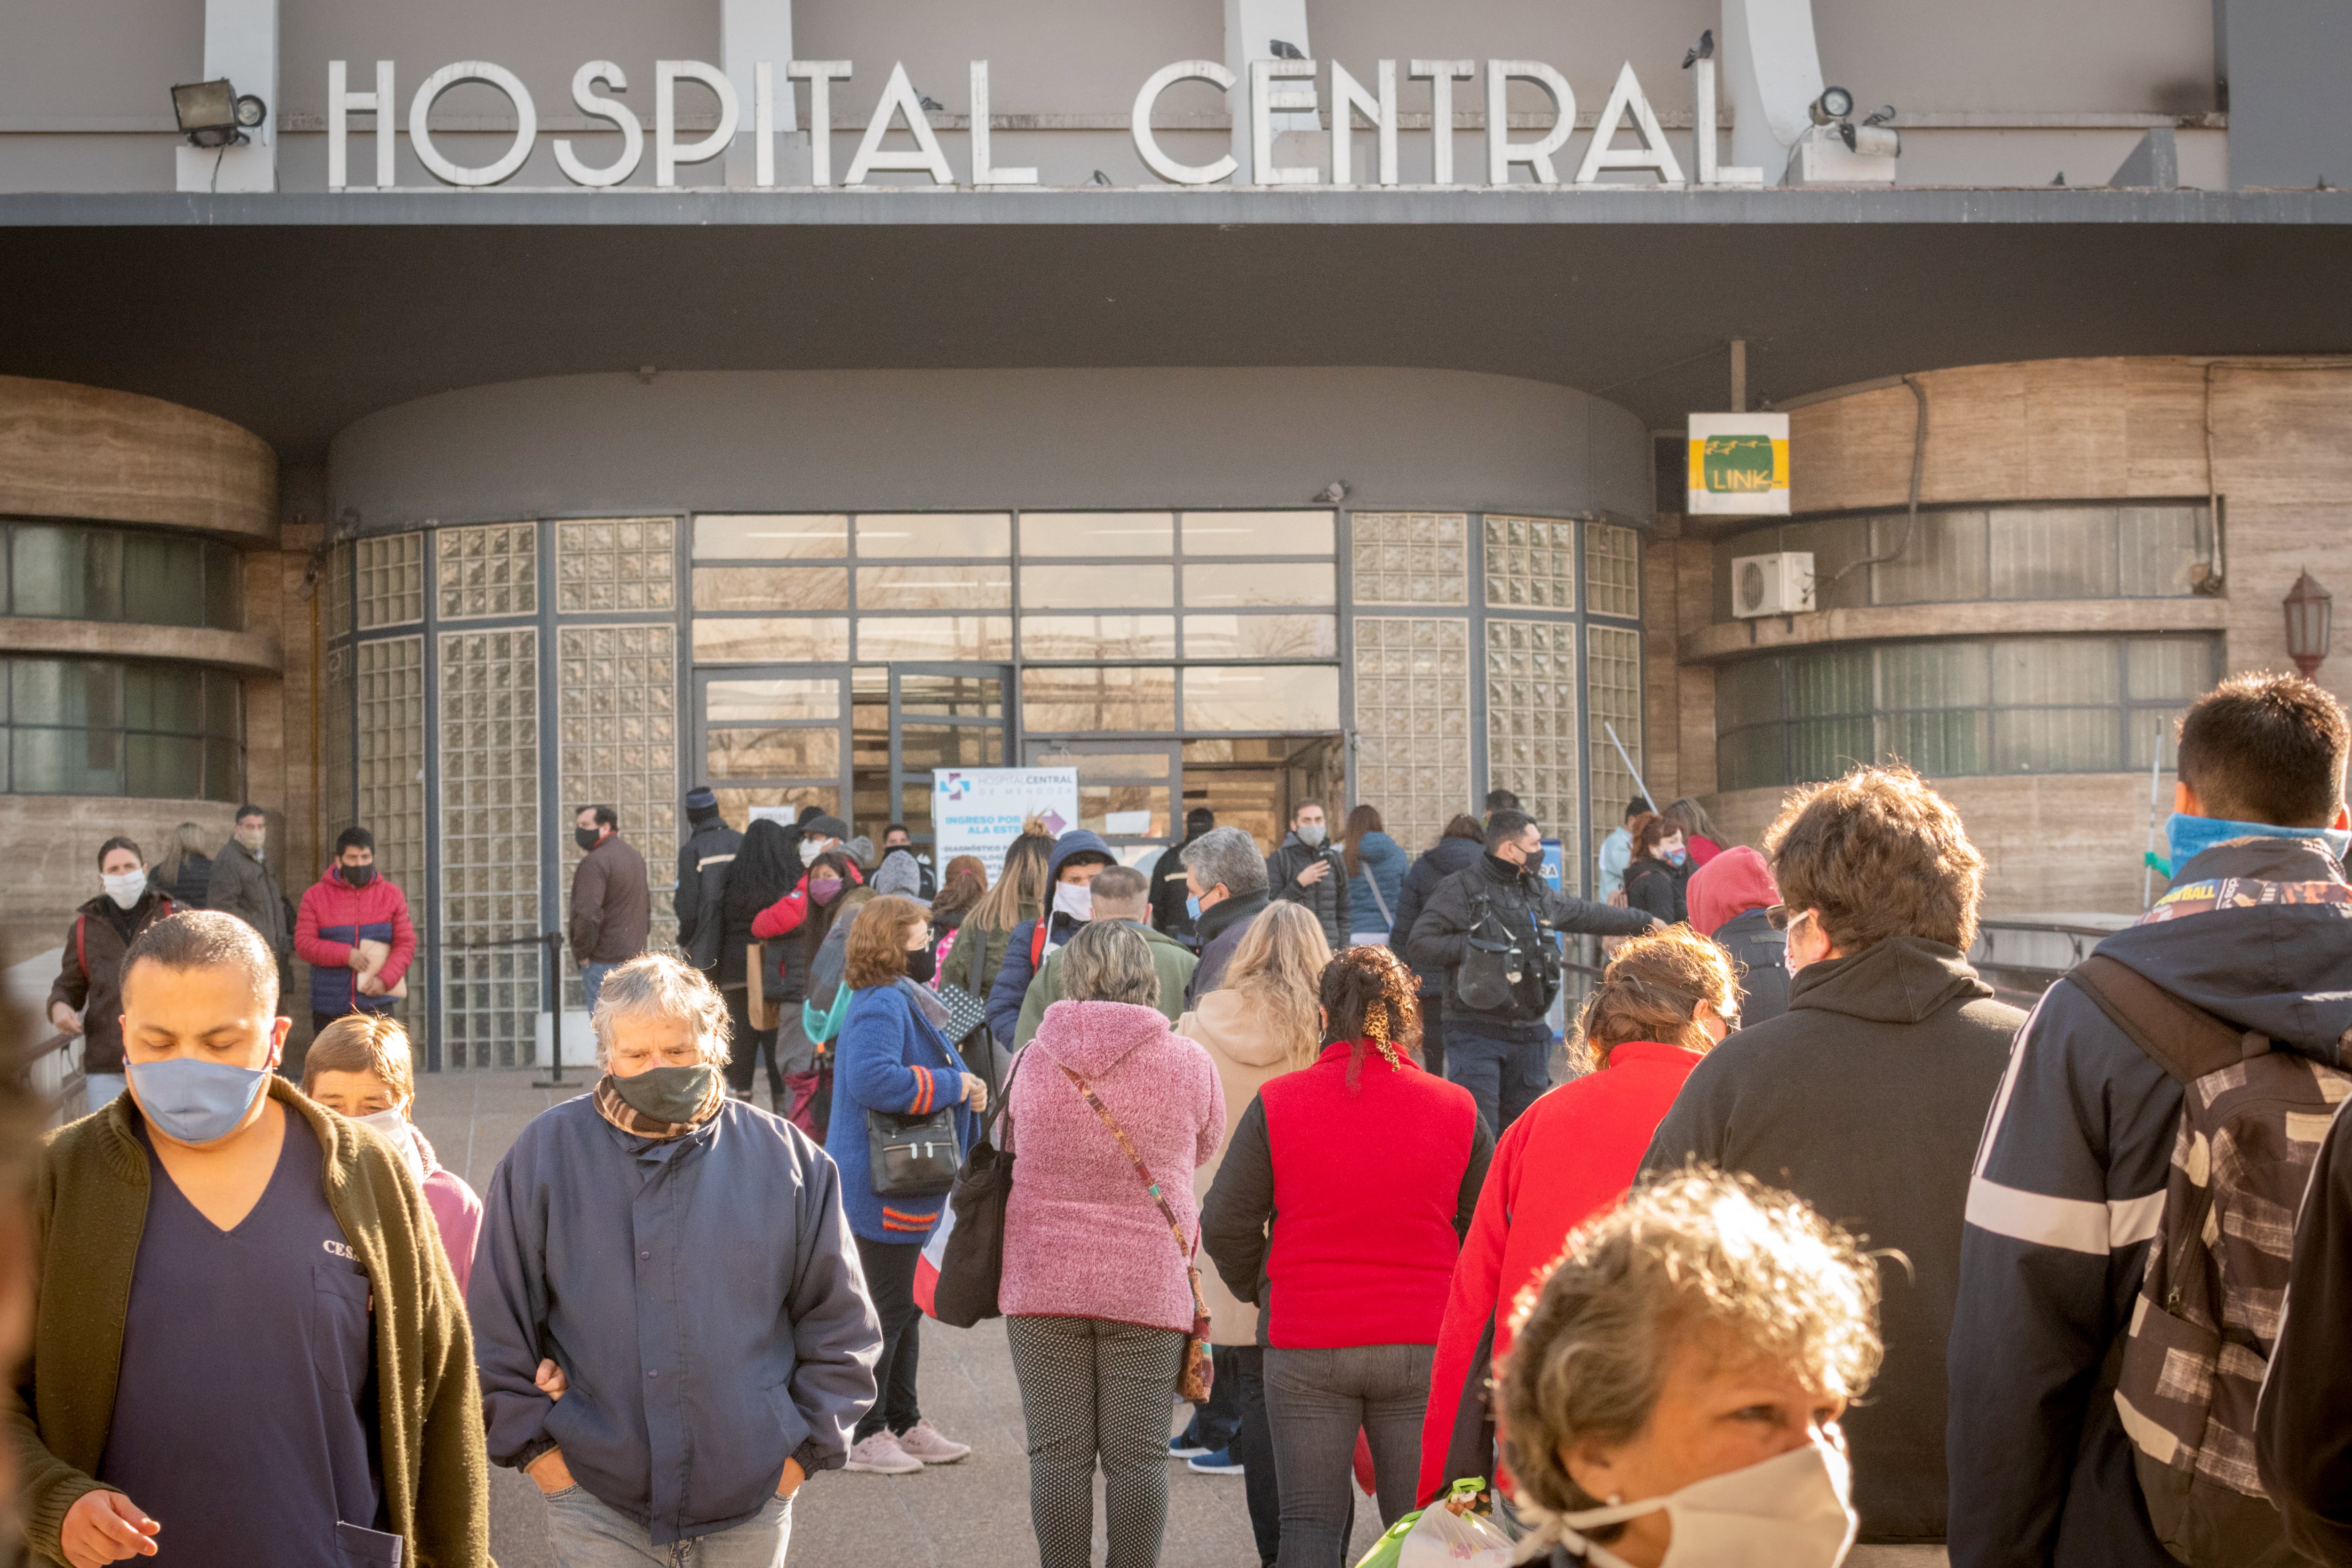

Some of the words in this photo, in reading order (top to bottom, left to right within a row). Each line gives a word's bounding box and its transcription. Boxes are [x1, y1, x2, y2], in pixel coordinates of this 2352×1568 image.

[328, 60, 1038, 186] HOSPITAL
[1131, 58, 1764, 186] CENTRAL
[1713, 469, 1780, 490] LINK
[1006, 786, 1073, 795] MENDOZA
[946, 816, 995, 825] INGRESO
[998, 815, 1020, 824] POR
[967, 826, 990, 835] ALA
